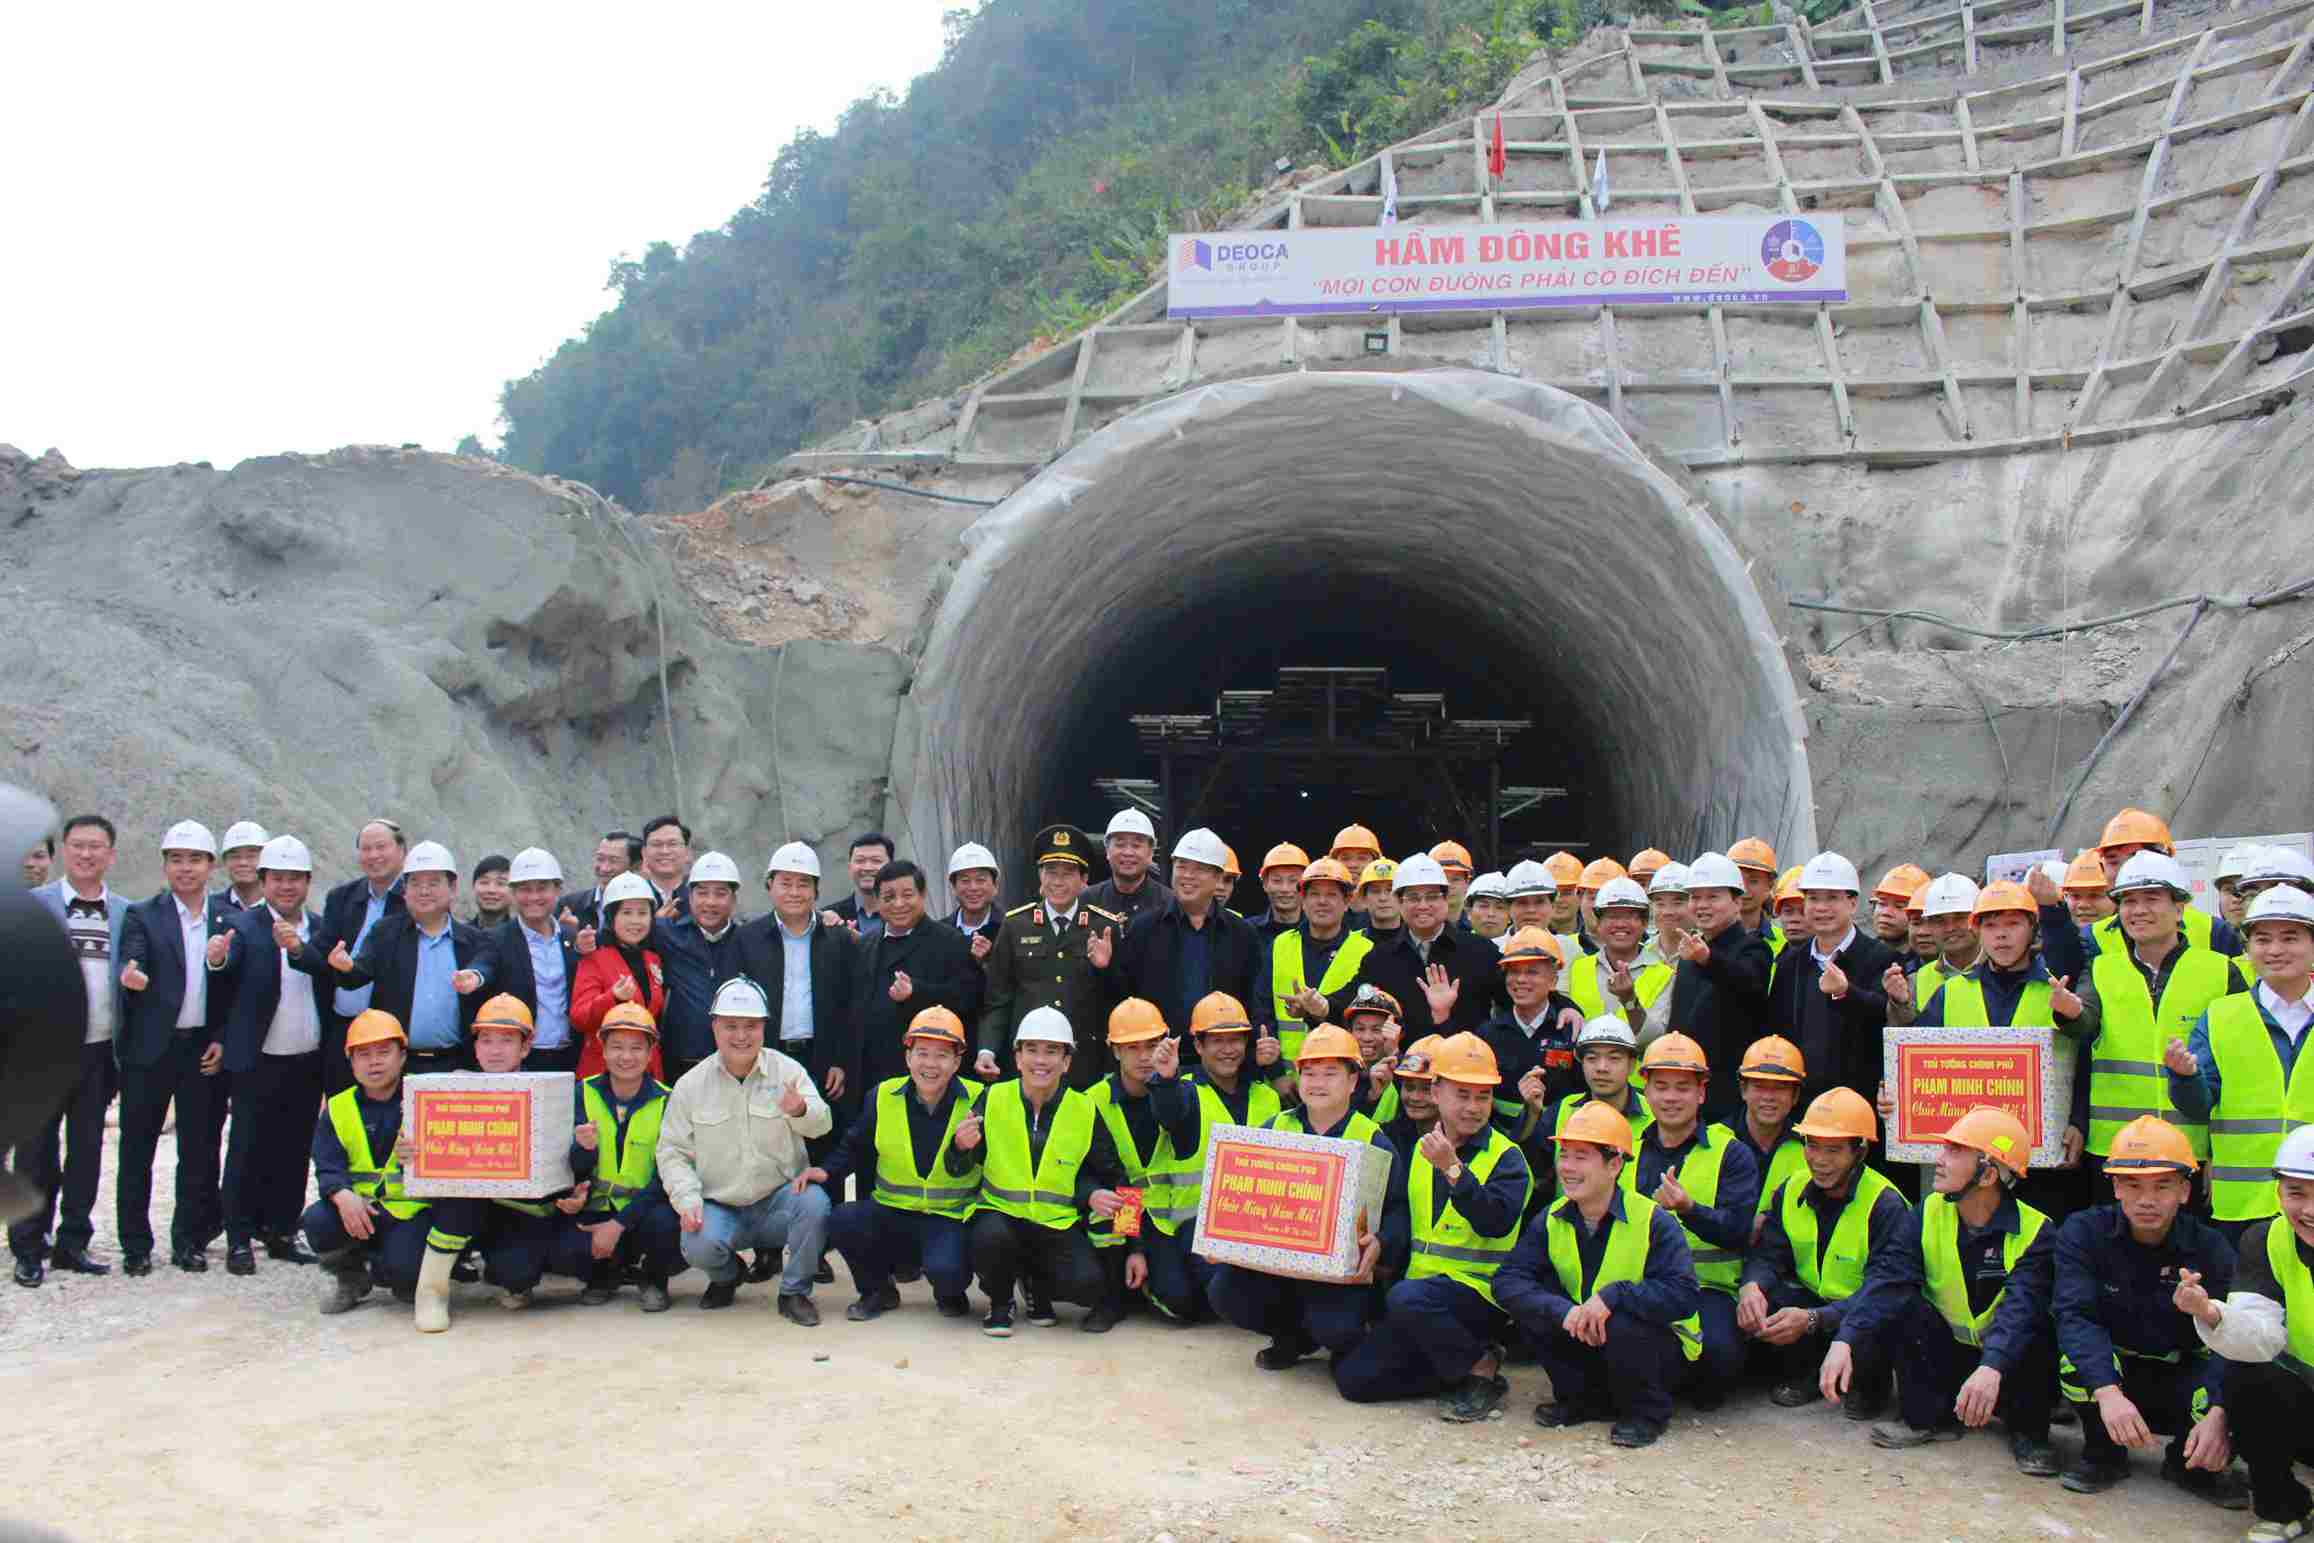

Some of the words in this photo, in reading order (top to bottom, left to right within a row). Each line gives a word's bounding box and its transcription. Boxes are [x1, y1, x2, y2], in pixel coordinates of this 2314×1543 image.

[1216, 243, 1288, 262] DEOCA
[1375, 228, 1465, 266] HẦM
[1478, 228, 1591, 264] ĐÔNG
[1371, 276, 1421, 295] CON
[1913, 1077, 1947, 1098] PHẠM
[1951, 1078, 1984, 1096] MINH
[1986, 1075, 2024, 1097] CHÍNH
[1221, 1173, 1253, 1195] PHẠM
[1256, 1178, 1287, 1197] MINH
[1289, 1179, 1324, 1201] CHÍNH
